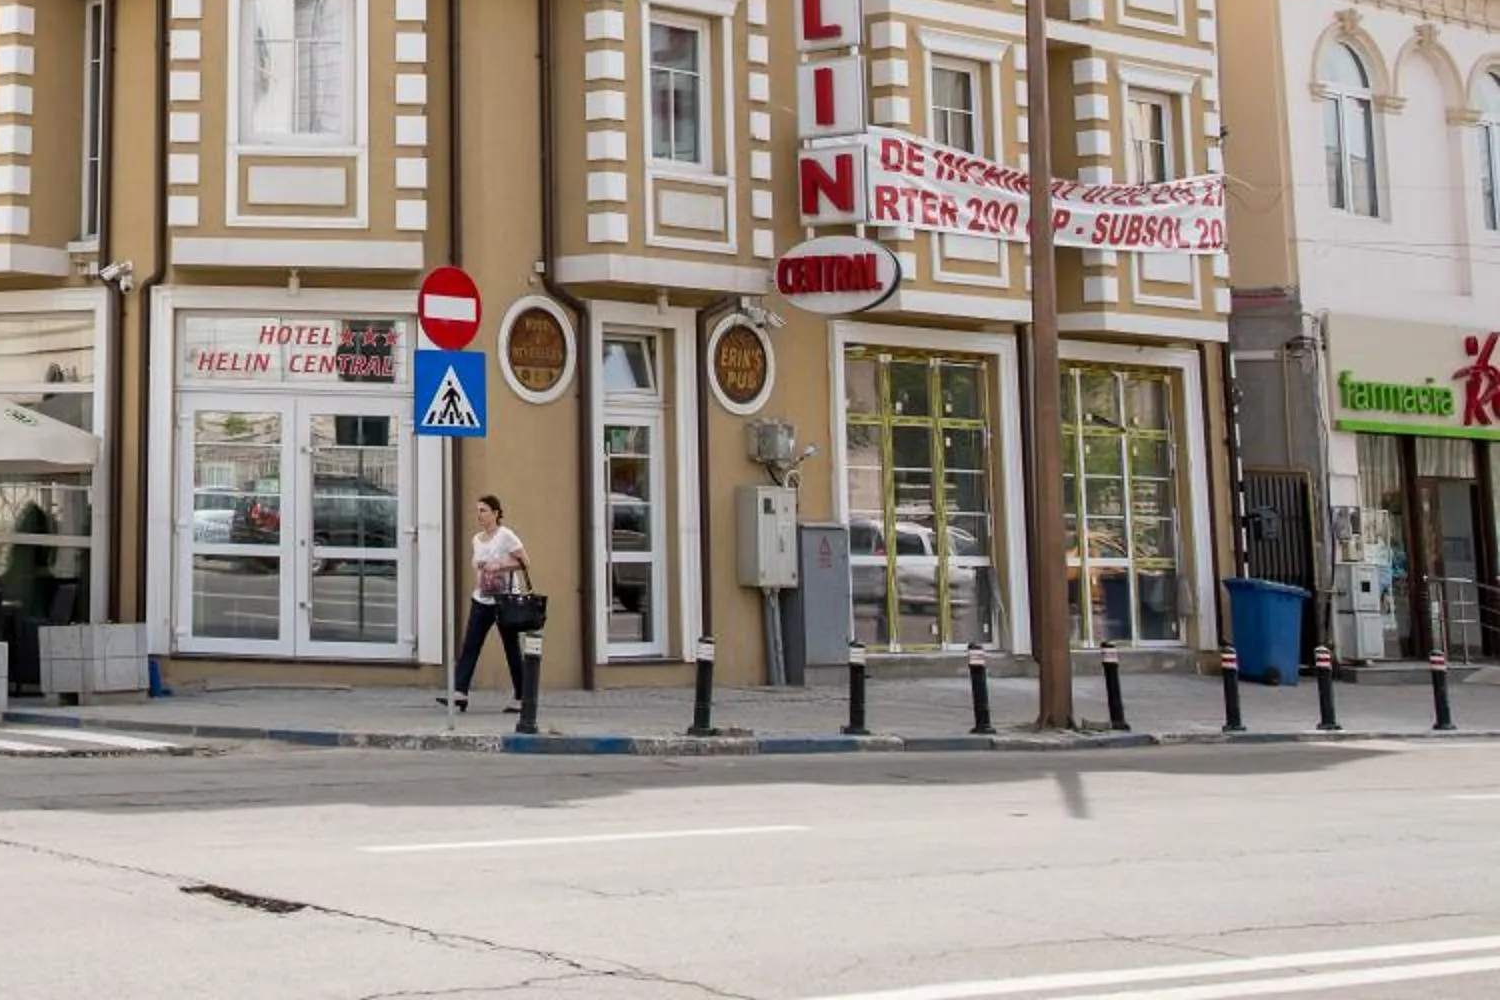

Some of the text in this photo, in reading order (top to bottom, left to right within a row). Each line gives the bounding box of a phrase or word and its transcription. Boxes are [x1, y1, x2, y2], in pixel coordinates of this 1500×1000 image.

[880, 138, 924, 176] DE
[870, 185, 959, 228] RTER
[966, 198, 1019, 235] 200
[1091, 212, 1190, 249] SUBSOL
[777, 254, 883, 294] CENTRAL
[259, 326, 333, 345] HOTEL
[198, 354, 395, 376] HELIN CENTRAL
[1338, 370, 1454, 416] farmacia
